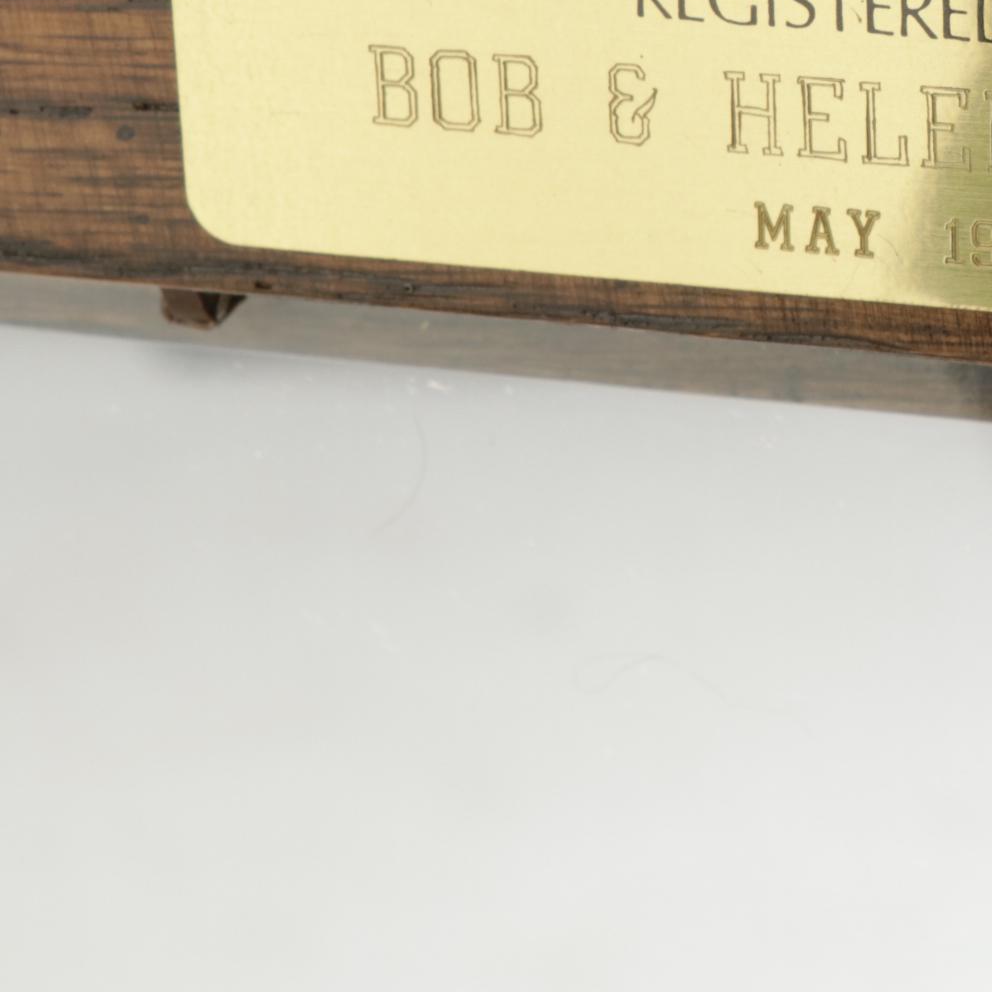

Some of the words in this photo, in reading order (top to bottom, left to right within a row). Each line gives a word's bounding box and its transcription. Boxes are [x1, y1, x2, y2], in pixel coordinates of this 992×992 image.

[368, 44, 544, 138] BOB
[607, 62, 658, 147] &
[753, 200, 882, 259] MAY
